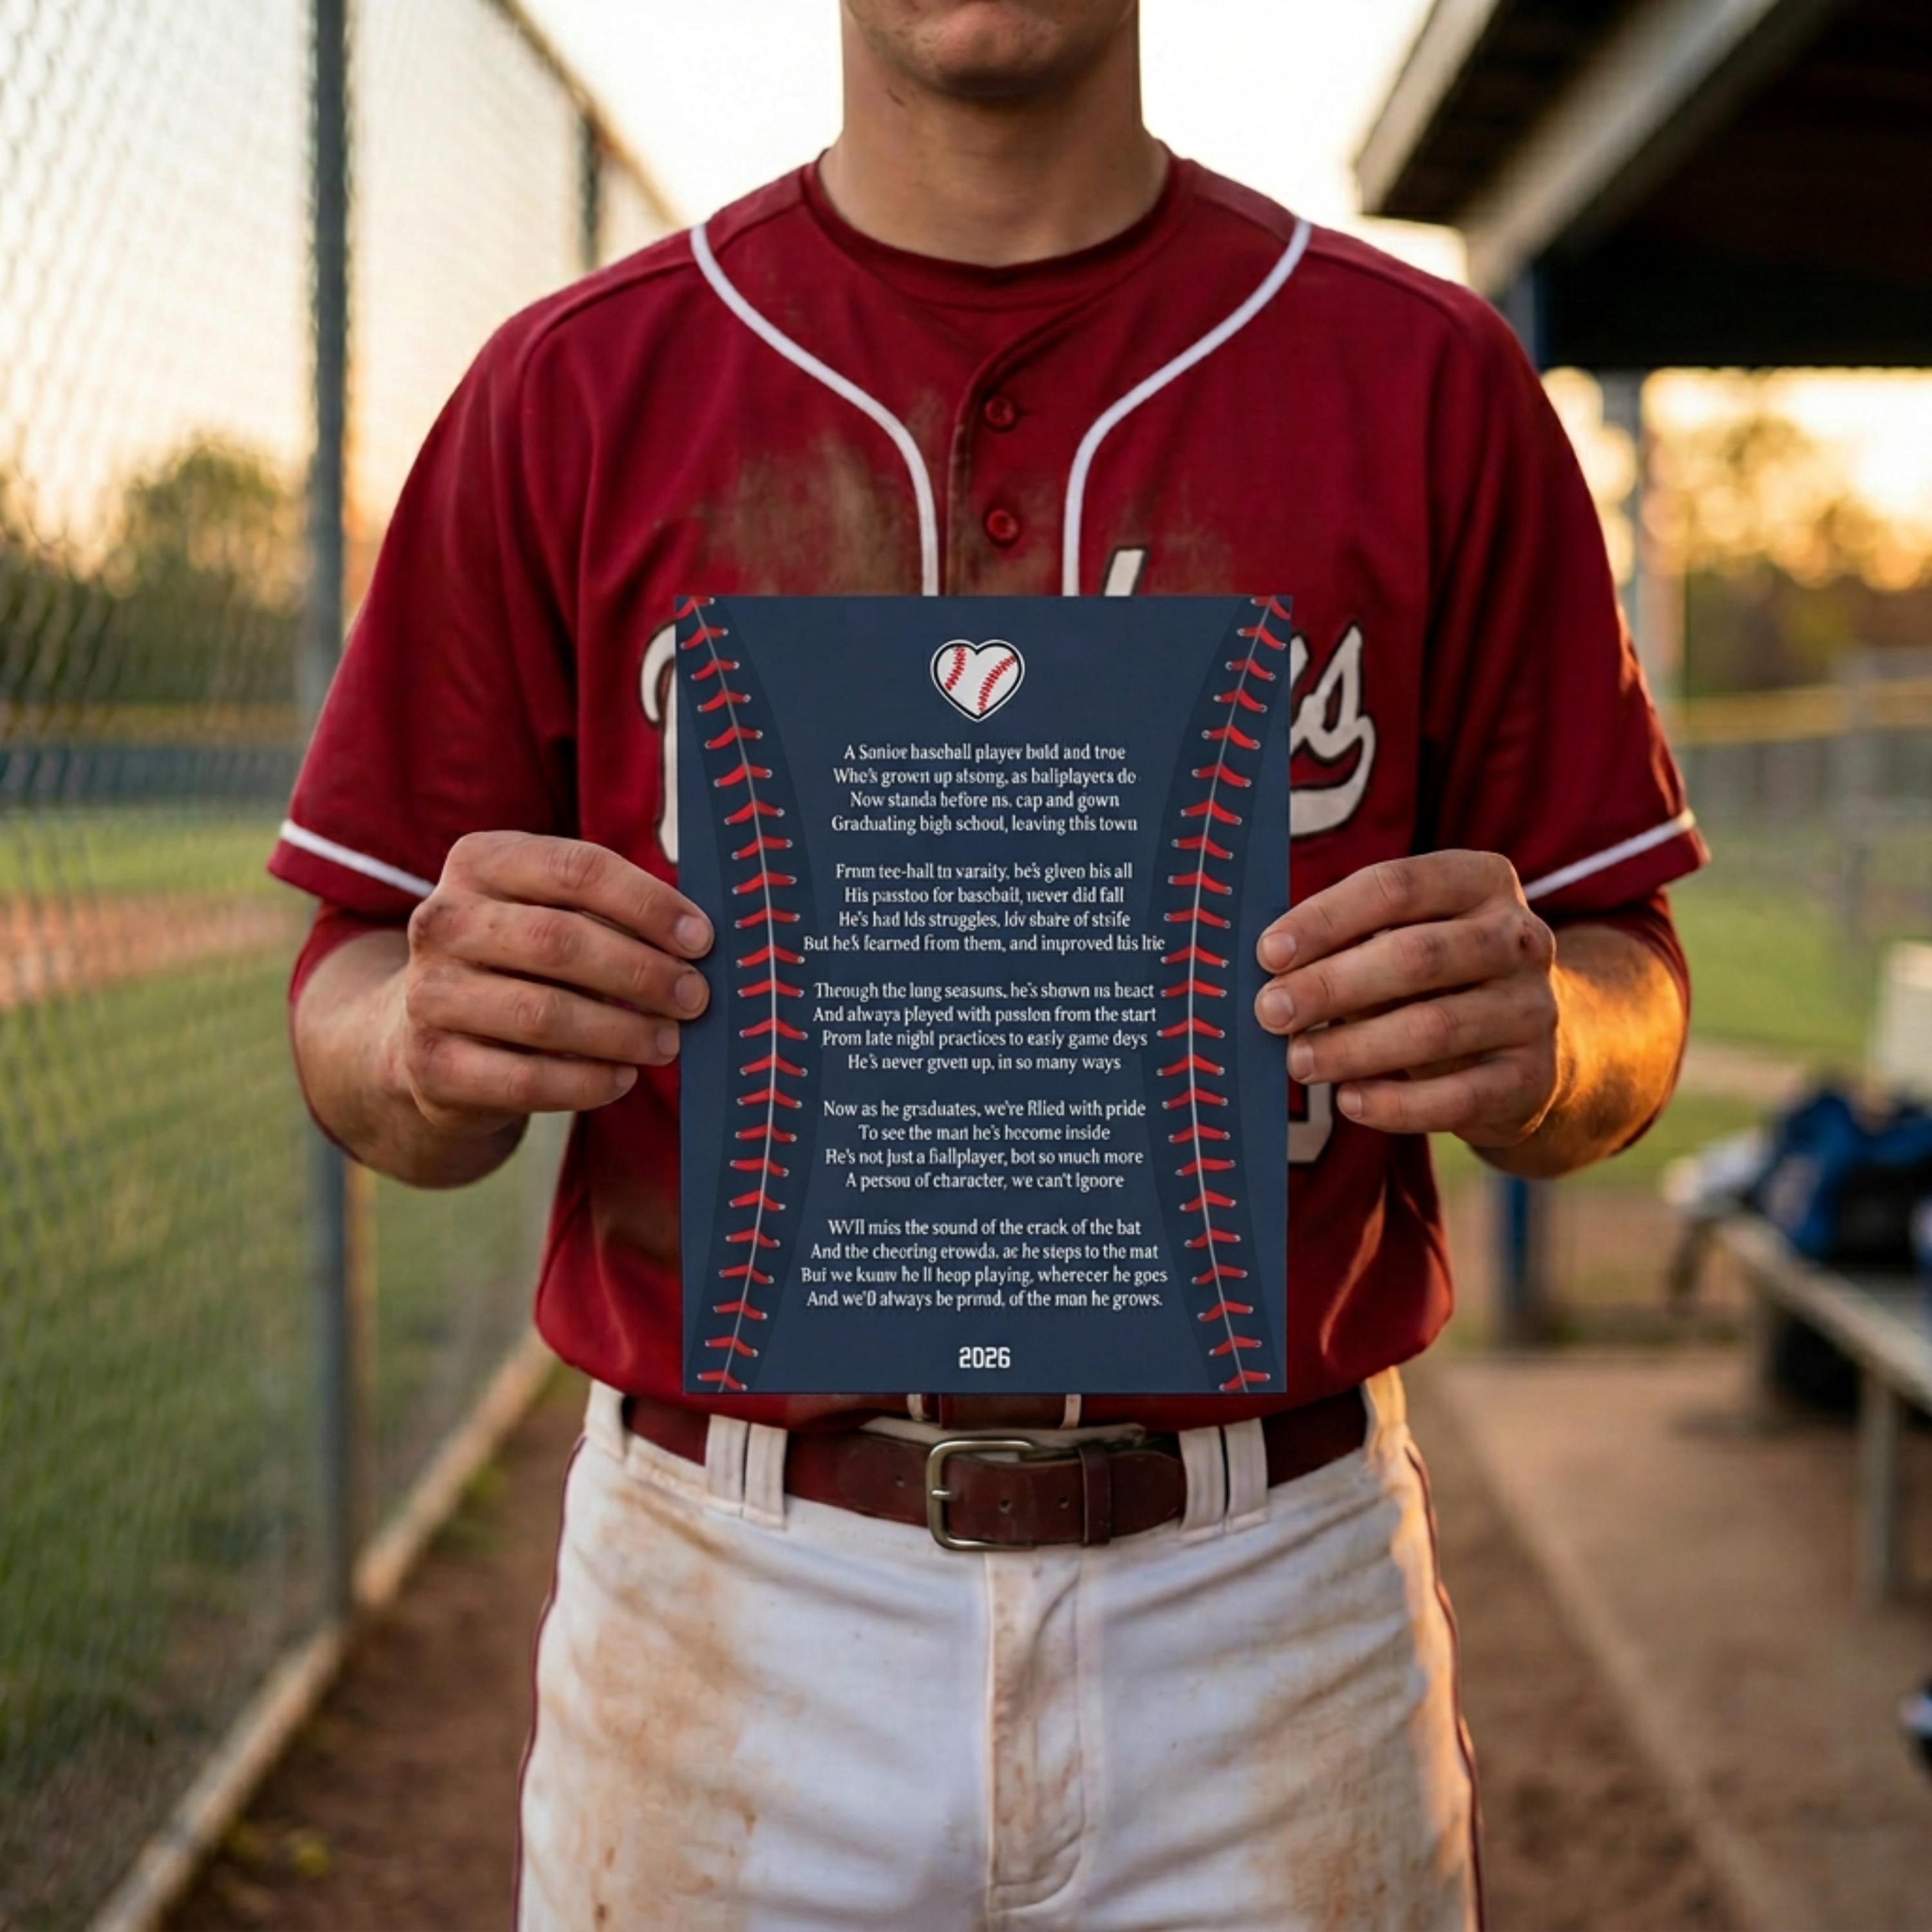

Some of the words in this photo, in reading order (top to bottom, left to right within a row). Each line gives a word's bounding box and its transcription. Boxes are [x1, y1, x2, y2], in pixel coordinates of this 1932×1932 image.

[843, 744, 856, 761] A
[933, 771, 953, 788] up
[1010, 771, 1028, 784] as
[1117, 767, 1137, 784] do
[850, 791, 886, 808] Now
[1016, 795, 1043, 812] cap
[1045, 791, 1074, 808] and
[1077, 795, 1120, 812] gown
[1068, 815, 1097, 831] this
[1099, 817, 1138, 831] town
[1114, 862, 1133, 879] all
[844, 886, 869, 903] His
[933, 886, 955, 903] for
[1072, 886, 1097, 903] did
[1099, 886, 1124, 903] fall
[838, 910, 869, 927] He's
[873, 910, 900, 927] had
[1073, 910, 1090, 927] of
[923, 934, 960, 951] from
[963, 935, 1007, 952] them,
[1009, 934, 1037, 951] and
[1010, 981, 1038, 998] he's
[812, 1005, 844, 1022] And
[956, 1005, 992, 1022] with
[1054, 1005, 1092, 1022] from
[1094, 1005, 1119, 1022] the
[1121, 1007, 1156, 1022] start
[866, 1029, 893, 1046] late
[1009, 1032, 1024, 1046] to
[1068, 1033, 1110, 1050] game
[848, 1053, 878, 1070] He's
[998, 1054, 1012, 1069] in
[1016, 1057, 1033, 1070] so
[1036, 1057, 1078, 1074] many
[1081, 1057, 1121, 1074] ways
[824, 1100, 858, 1117] Now
[861, 1104, 878, 1117] as
[881, 1099, 900, 1117] he
[1068, 1099, 1103, 1117] with
[1105, 1099, 1146, 1121] pride
[858, 1124, 878, 1141] To
[909, 1124, 933, 1141] the
[972, 1124, 1001, 1141] he's
[1065, 1124, 1111, 1141] inside
[859, 1150, 884, 1165] not
[916, 1152, 925, 1165] a
[1038, 1152, 1056, 1164] so
[1104, 1152, 1144, 1164] more
[845, 1171, 857, 1188] A
[914, 1171, 932, 1188] of
[1011, 1175, 1034, 1188] we
[905, 1218, 929, 1235] the
[931, 1218, 978, 1235] sound
[981, 1218, 997, 1235] of
[999, 1218, 1023, 1235] the
[1071, 1218, 1088, 1235] of
[1116, 1218, 1142, 1235] bat
[810, 1242, 841, 1259] And
[1021, 1242, 1040, 1259] he
[1084, 1244, 1100, 1259] to
[1103, 1242, 1127, 1259] the
[1130, 1244, 1159, 1259] mat
[829, 1271, 853, 1283] we
[1113, 1266, 1131, 1283] he
[806, 1290, 838, 1307] And
[936, 1290, 954, 1307] be
[1009, 1290, 1027, 1307] of
[1027, 1290, 1052, 1307] the
[1091, 1290, 1110, 1307] he
[958, 1346, 1011, 1369] 2026
